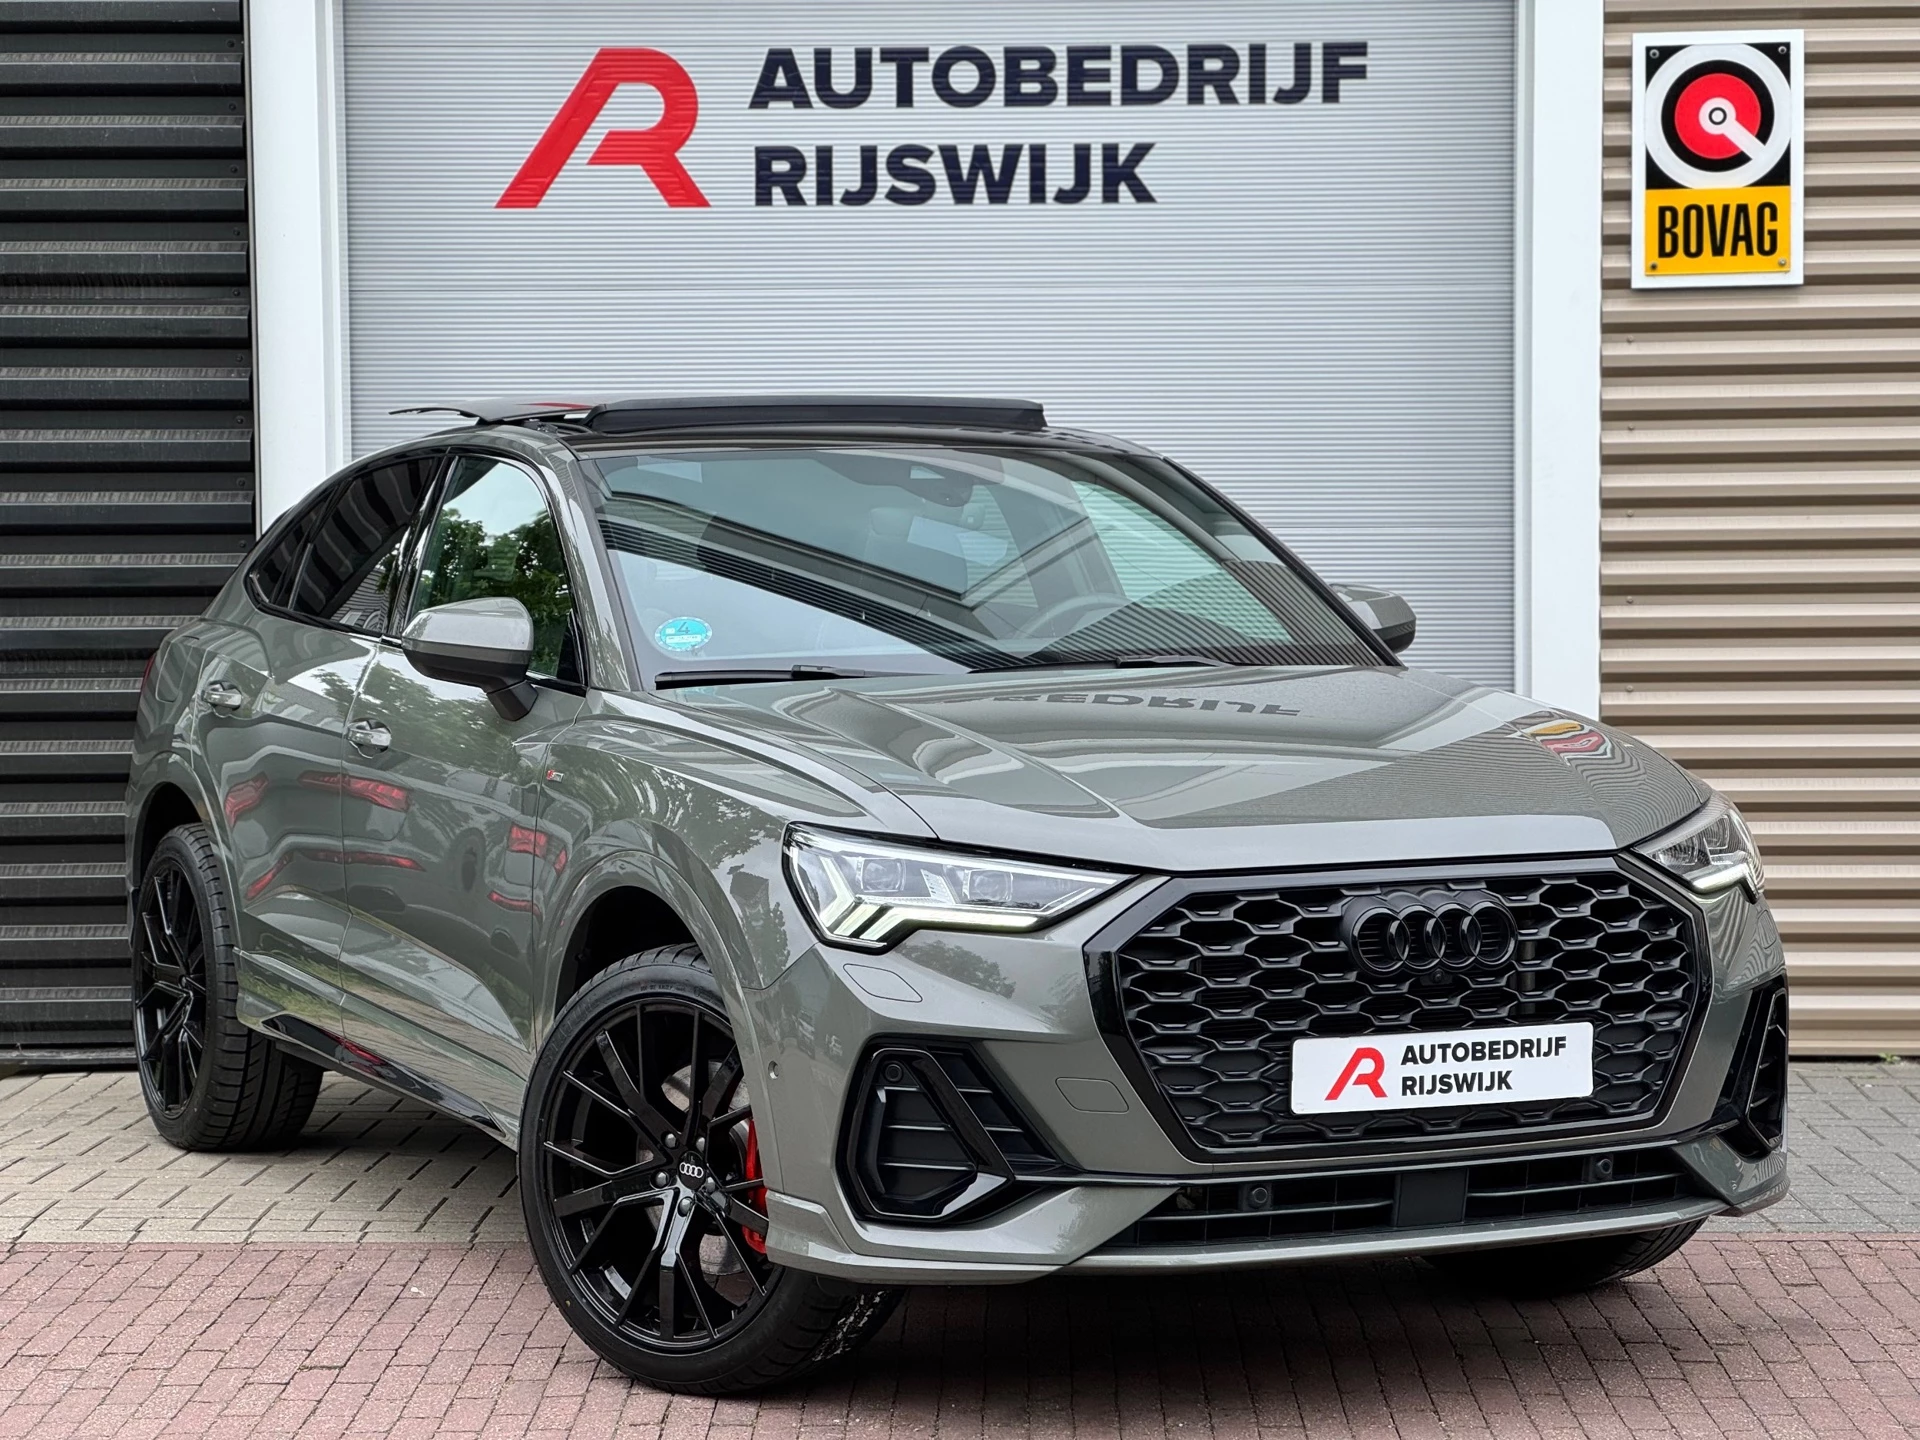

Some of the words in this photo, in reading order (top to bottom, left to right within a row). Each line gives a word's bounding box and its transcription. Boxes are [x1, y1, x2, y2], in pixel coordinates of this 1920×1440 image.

[749, 41, 1368, 110] AUTOBEDRIJF
[754, 143, 1157, 207] RIJSWIJK
[1657, 201, 1778, 259] BOVAG
[1400, 1036, 1568, 1067] AUTOBEDRIJF
[1401, 1070, 1513, 1097] RIJSWIJK
